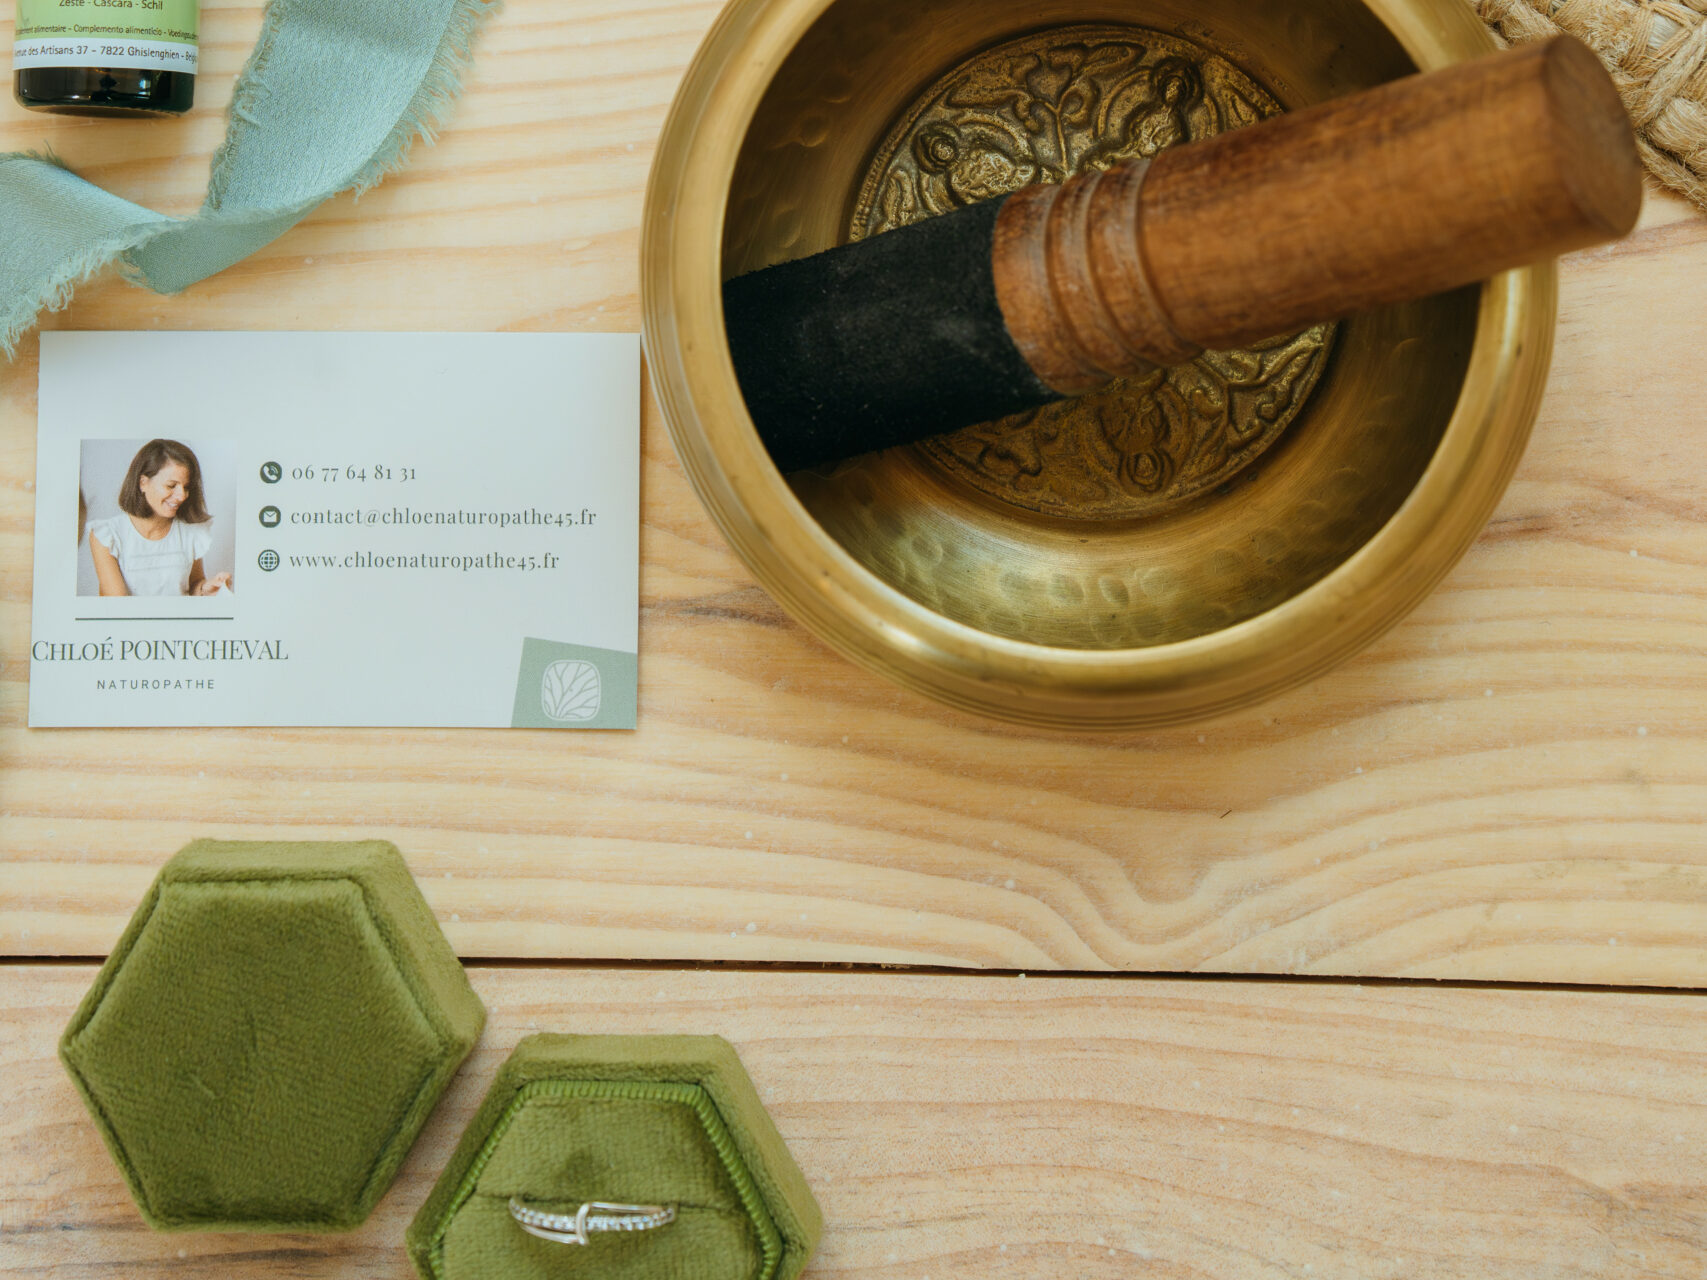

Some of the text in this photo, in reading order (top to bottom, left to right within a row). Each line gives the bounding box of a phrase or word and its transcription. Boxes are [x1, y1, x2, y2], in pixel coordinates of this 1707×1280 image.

[141, 0, 163, 10] Schil
[73, 23, 124, 34] Complemento
[27, 46, 39, 56] des
[40, 45, 74, 55] Artisans
[76, 45, 89, 55] 37
[100, 45, 125, 56] 7822
[127, 46, 180, 60] Ghislenghien
[292, 464, 417, 482] 06 77 64 81 31
[290, 507, 597, 529] contact@chloenaturopathe45.fr
[289, 551, 560, 571] www.chloenaturopathe45.fr
[119, 639, 289, 661] POINTCHEVAL
[96, 678, 216, 690] NATUROPATHE
